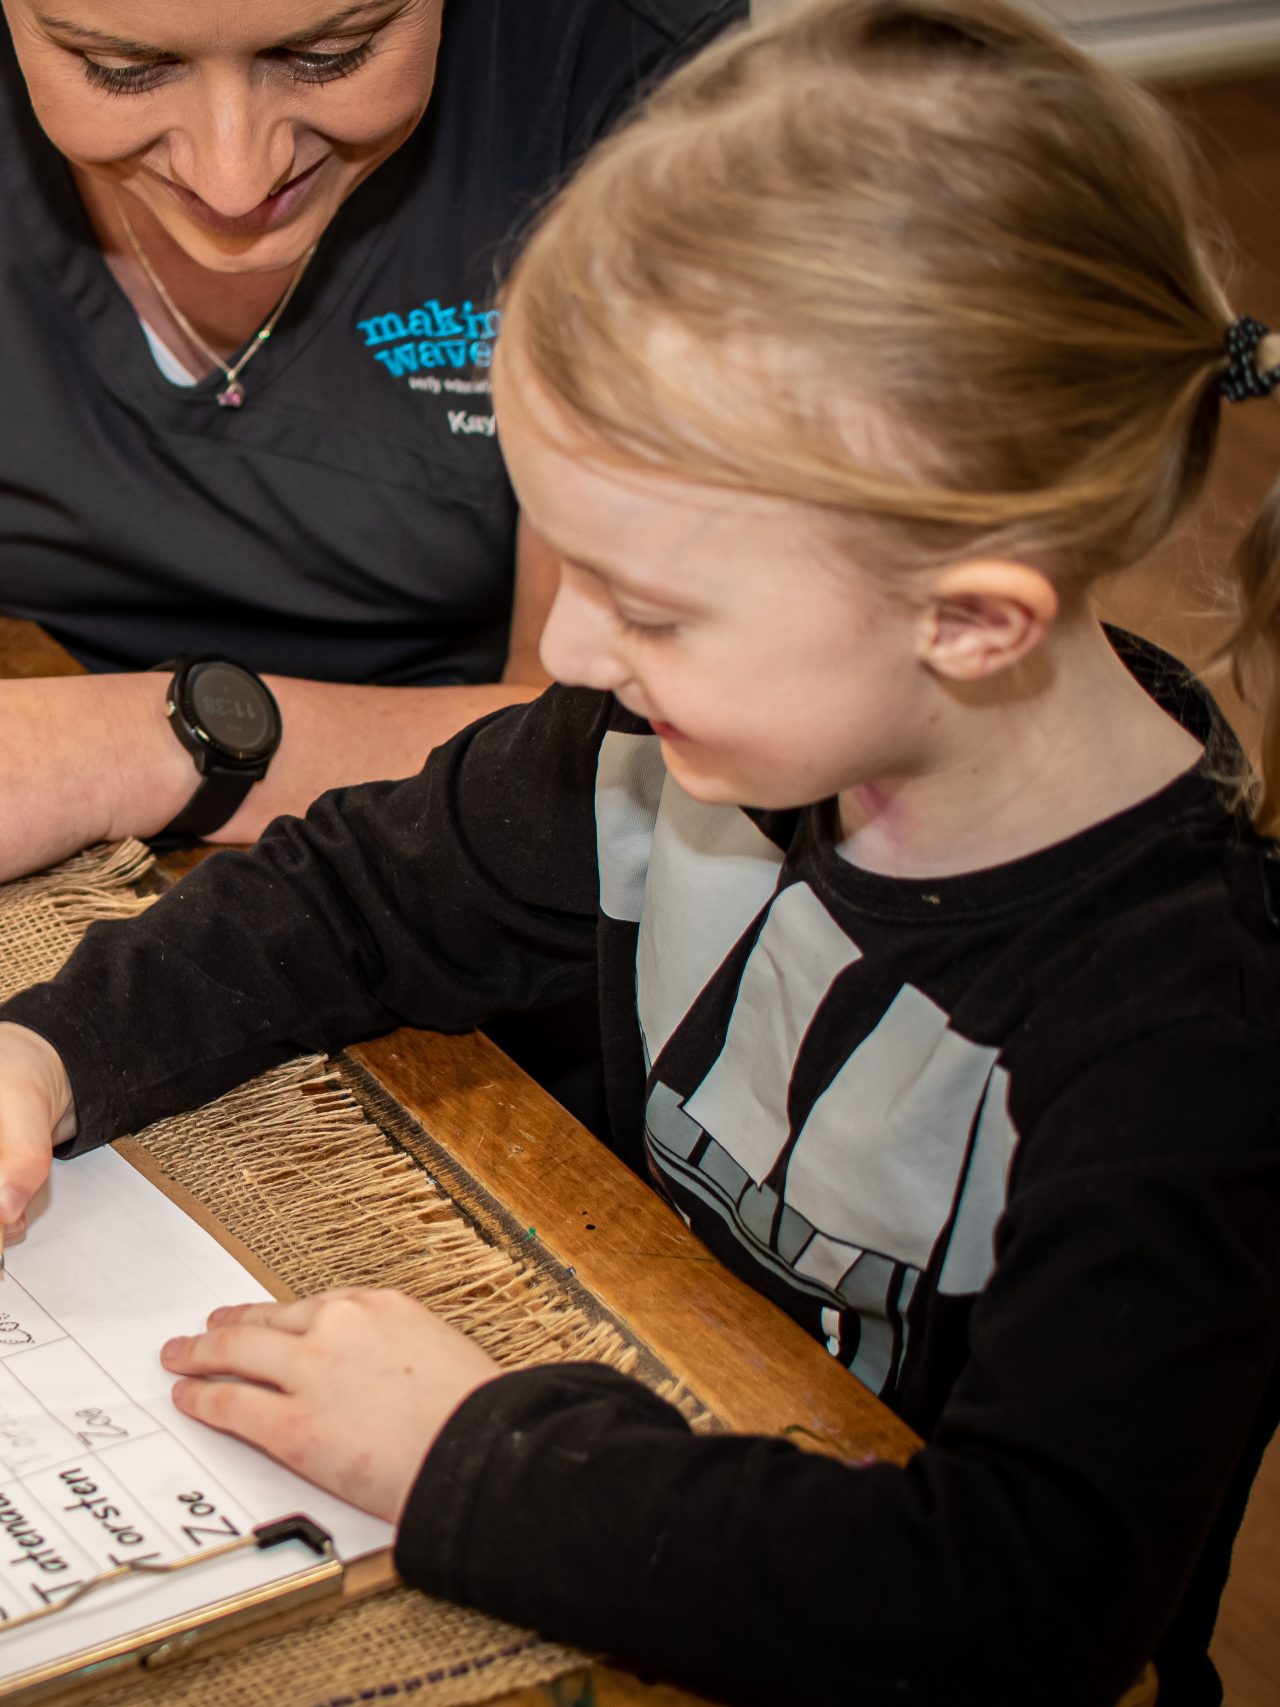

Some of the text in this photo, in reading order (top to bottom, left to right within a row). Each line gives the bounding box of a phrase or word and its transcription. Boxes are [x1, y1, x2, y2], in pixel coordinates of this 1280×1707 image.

[357, 299, 500, 346] makin
[74, 1407, 129, 1446] Zoe
[58, 1468, 162, 1568] Torsten
[177, 1490, 241, 1546] Zoe
